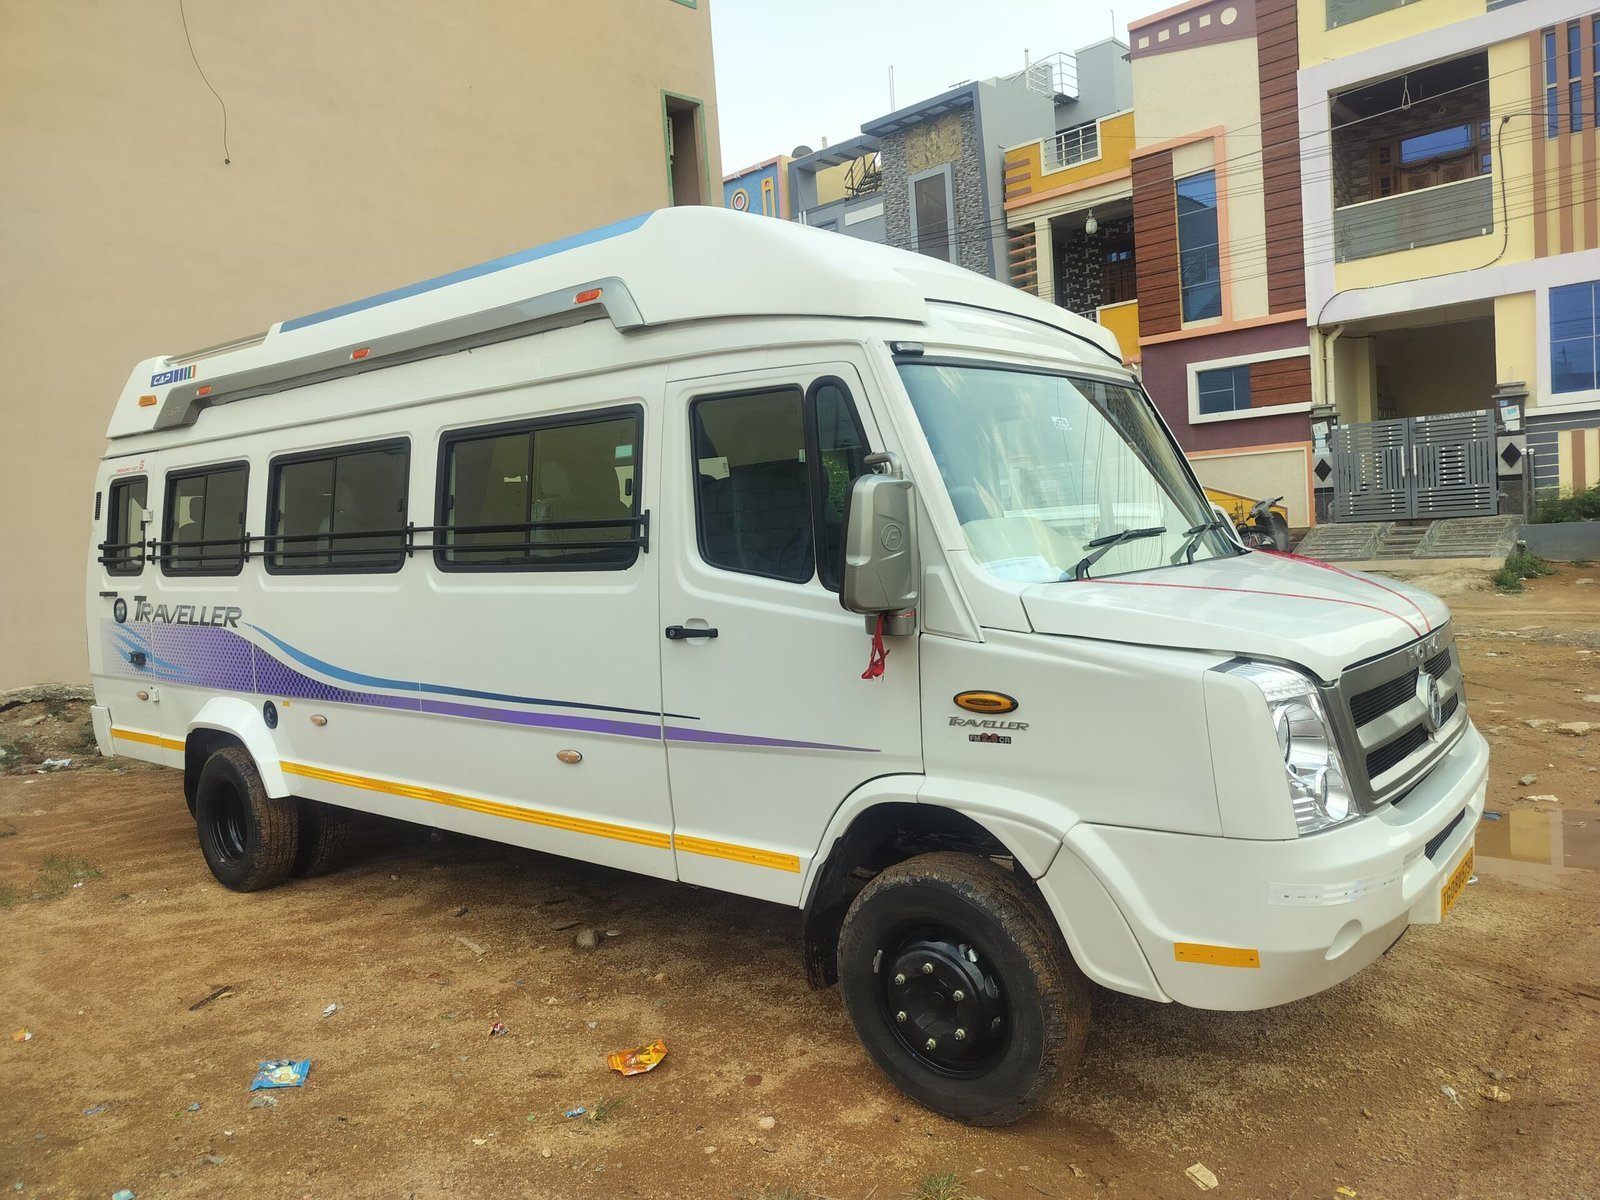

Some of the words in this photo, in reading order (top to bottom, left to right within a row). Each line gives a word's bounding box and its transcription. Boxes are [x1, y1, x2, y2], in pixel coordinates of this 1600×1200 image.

[153, 373, 171, 385] CAP
[133, 595, 243, 628] TRAVELLER
[948, 716, 1030, 731] TRAVELLER
